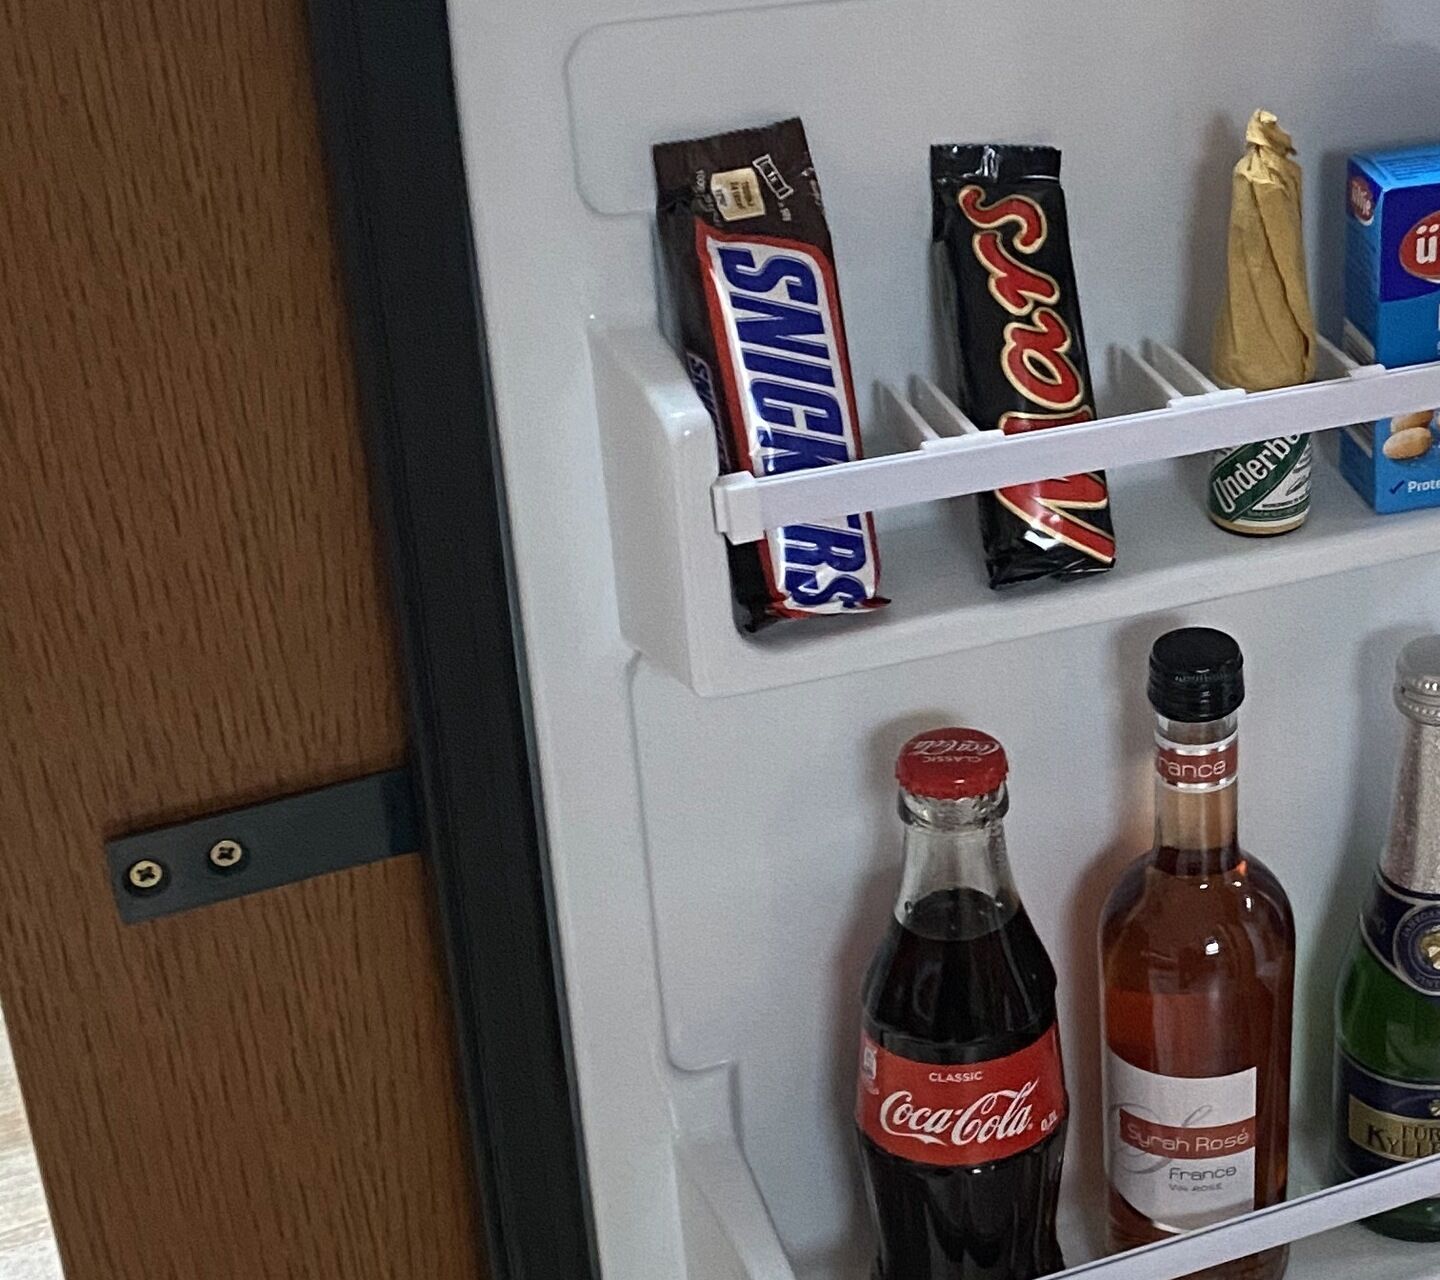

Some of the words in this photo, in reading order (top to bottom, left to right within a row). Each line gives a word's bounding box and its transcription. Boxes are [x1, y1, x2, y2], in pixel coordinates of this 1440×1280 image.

[958, 184, 1116, 564] Mars
[717, 247, 867, 609] SNICKRS
[912, 739, 1001, 756] Coca-Cola
[928, 1071, 985, 1083] CLASSIC
[880, 1076, 1040, 1146] Coca-Cola
[1127, 1122, 1190, 1153] Syrah
[1195, 1128, 1249, 1153] Rosé
[1168, 1165, 1237, 1181] France
